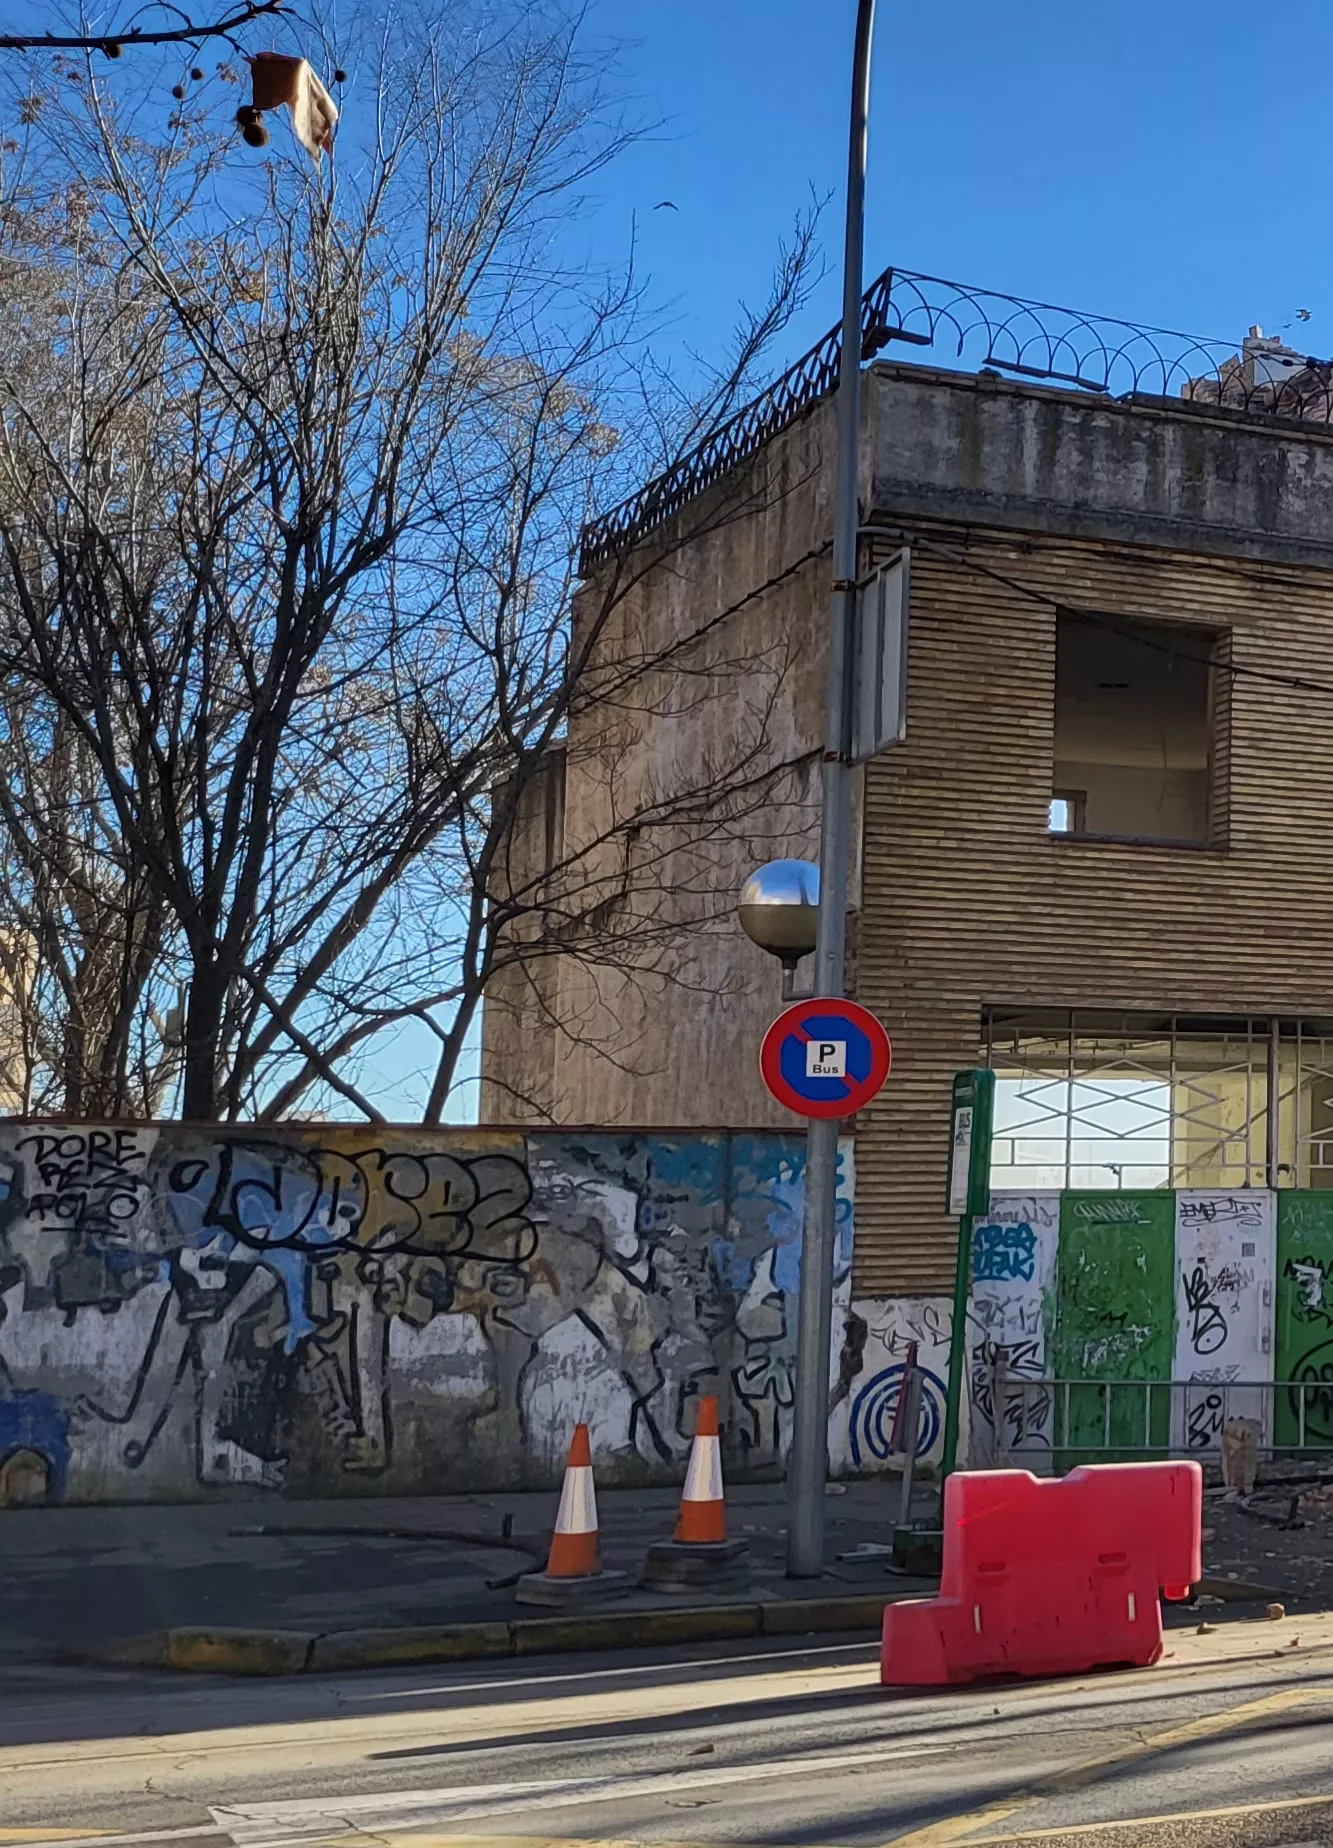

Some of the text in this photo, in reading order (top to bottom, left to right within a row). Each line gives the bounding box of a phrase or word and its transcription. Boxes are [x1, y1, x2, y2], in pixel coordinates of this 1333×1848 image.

[818, 1043, 836, 1063] P
[812, 1064, 839, 1074] Bus
[14, 1131, 146, 1166] DORE
